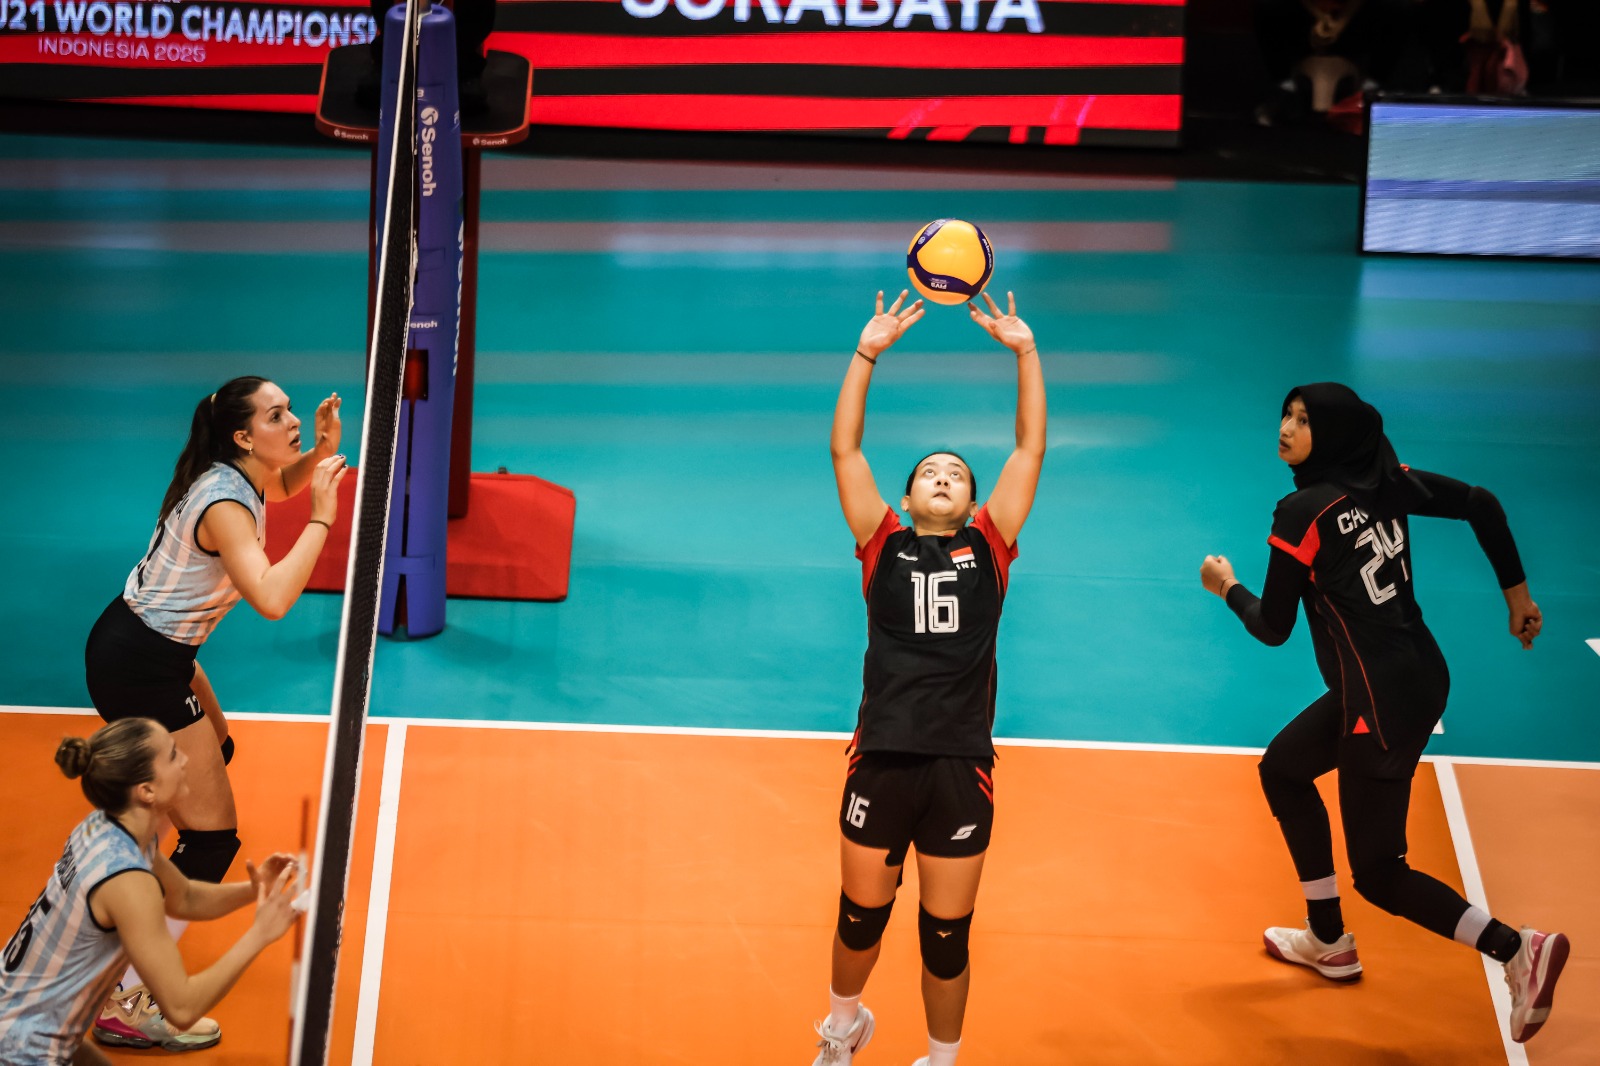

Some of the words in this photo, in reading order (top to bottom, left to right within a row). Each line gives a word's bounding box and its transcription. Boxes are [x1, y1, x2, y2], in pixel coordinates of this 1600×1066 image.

[54, 1, 174, 39] WORLD
[181, 6, 377, 48] CHAMPIONS
[38, 37, 150, 60] INDONESIA
[153, 42, 207, 62] 2025
[341, 131, 369, 140] Senoh
[480, 138, 508, 146] Senoh
[421, 127, 437, 197] Senoh
[409, 320, 438, 329] enoh
[955, 561, 977, 570] INA
[1354, 518, 1409, 606] 24
[910, 570, 960, 634] 16
[845, 791, 870, 829] 16
